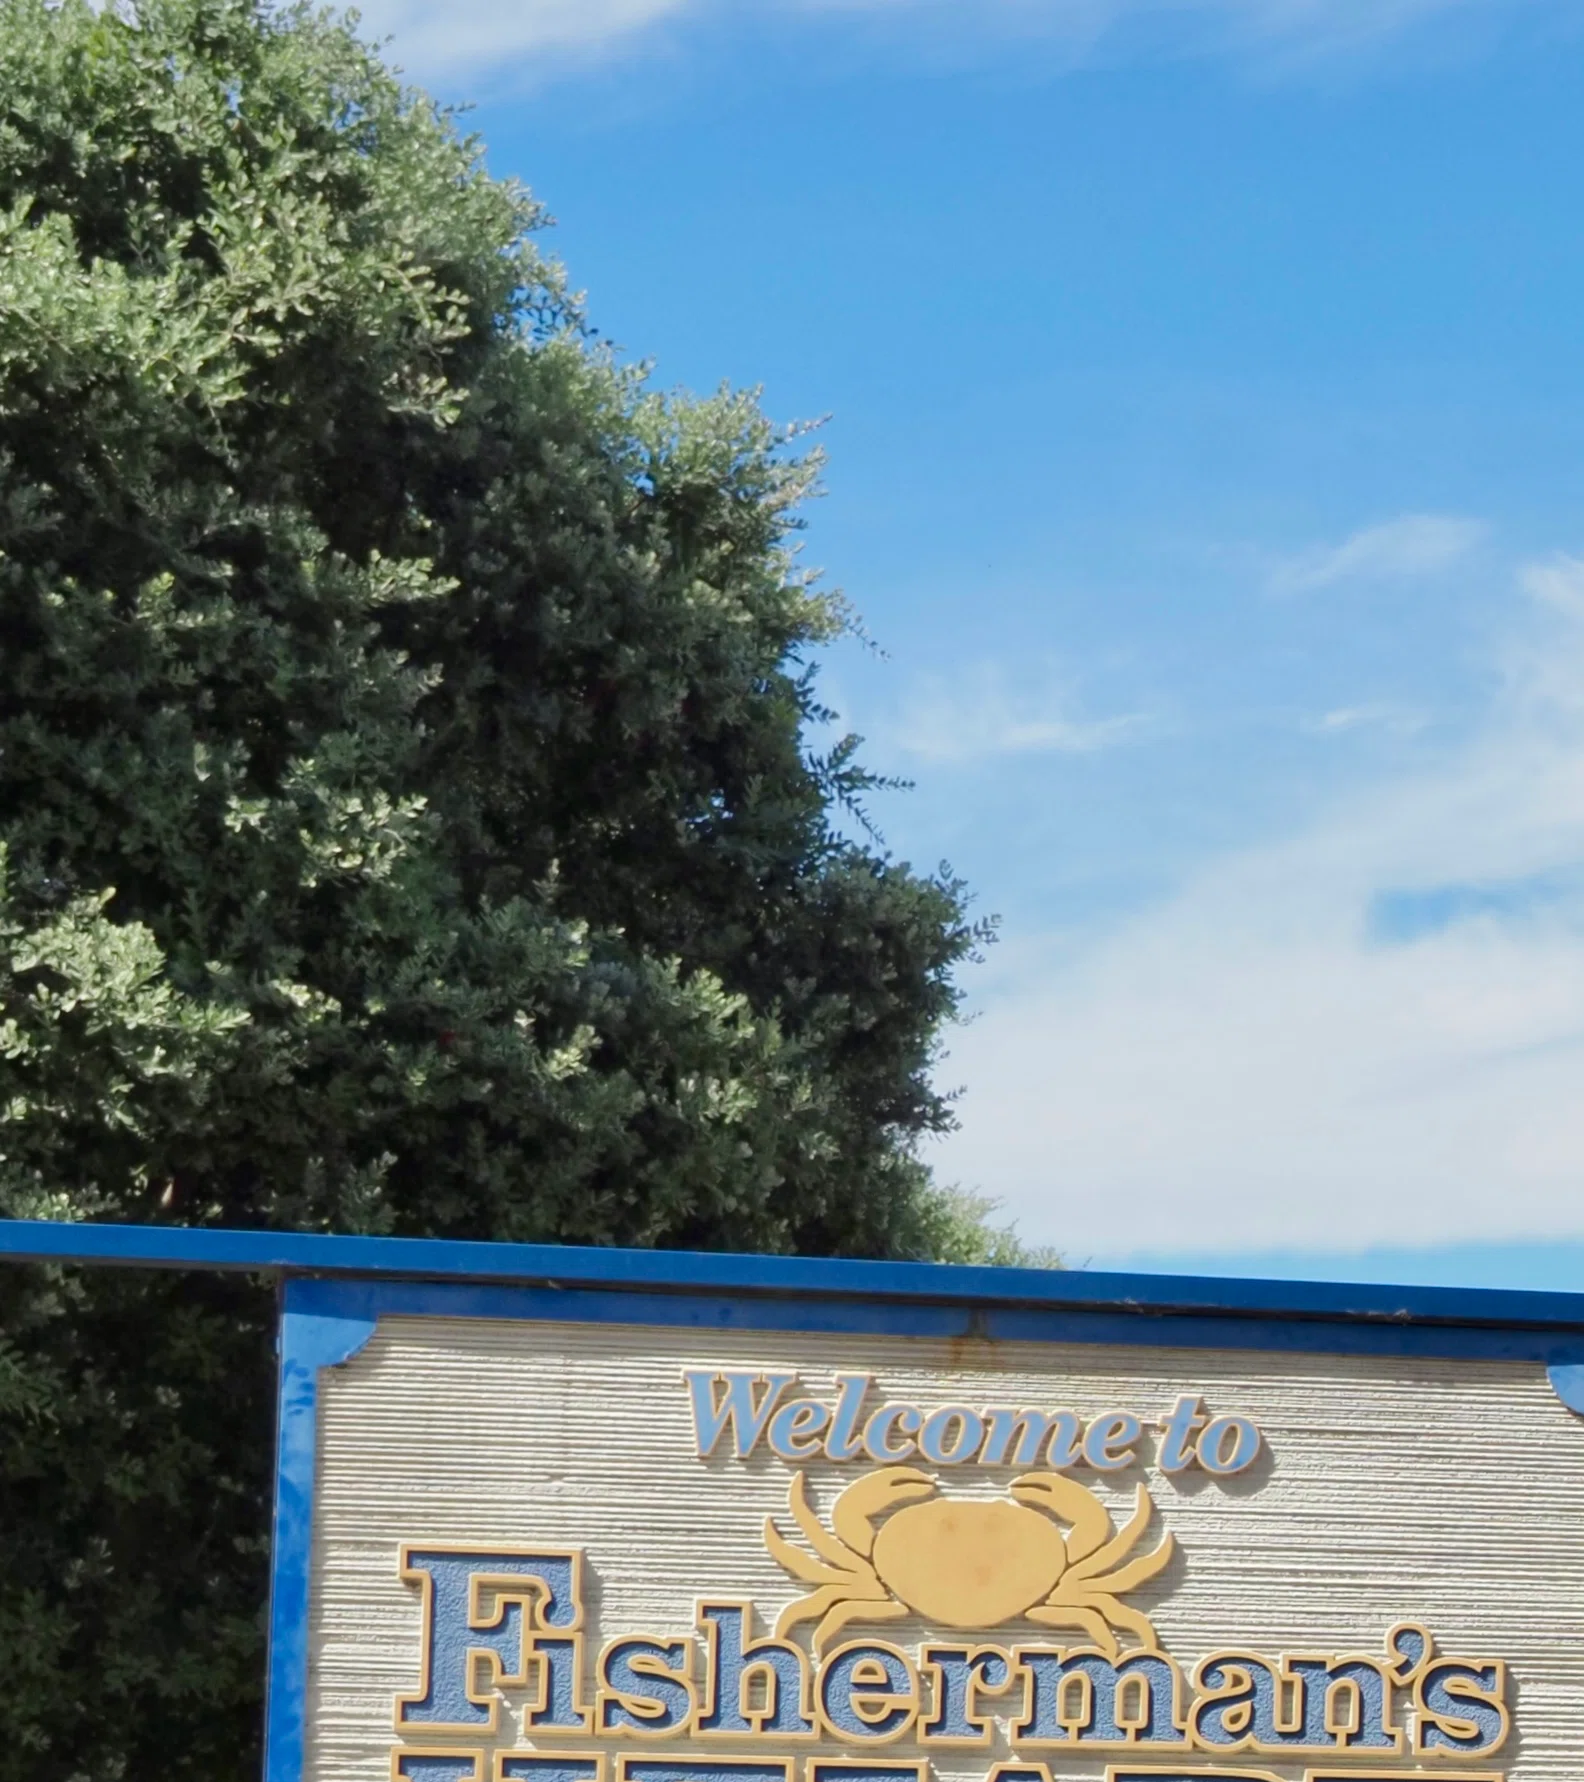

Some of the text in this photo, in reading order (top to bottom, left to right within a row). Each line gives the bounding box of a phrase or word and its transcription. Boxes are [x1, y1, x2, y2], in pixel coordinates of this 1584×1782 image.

[682, 1368, 1261, 1474] Welcome to
[394, 1542, 1511, 1758] Fisherman's
